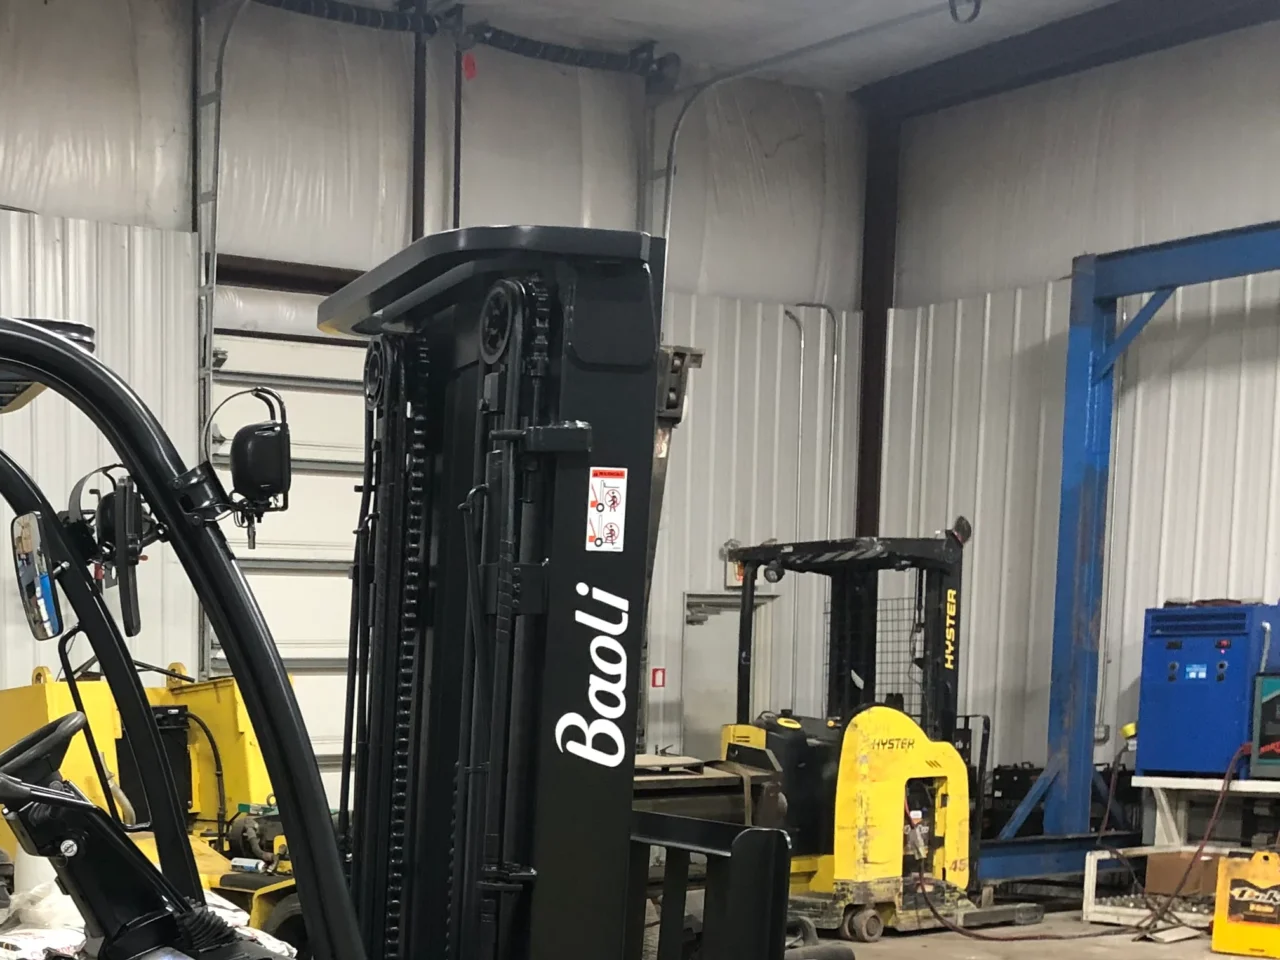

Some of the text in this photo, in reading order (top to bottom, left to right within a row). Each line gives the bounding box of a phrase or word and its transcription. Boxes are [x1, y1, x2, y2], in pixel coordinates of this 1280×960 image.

[944, 588, 957, 670] HYSTER
[554, 581, 630, 768] Baoli
[871, 738, 916, 750] HYSTER
